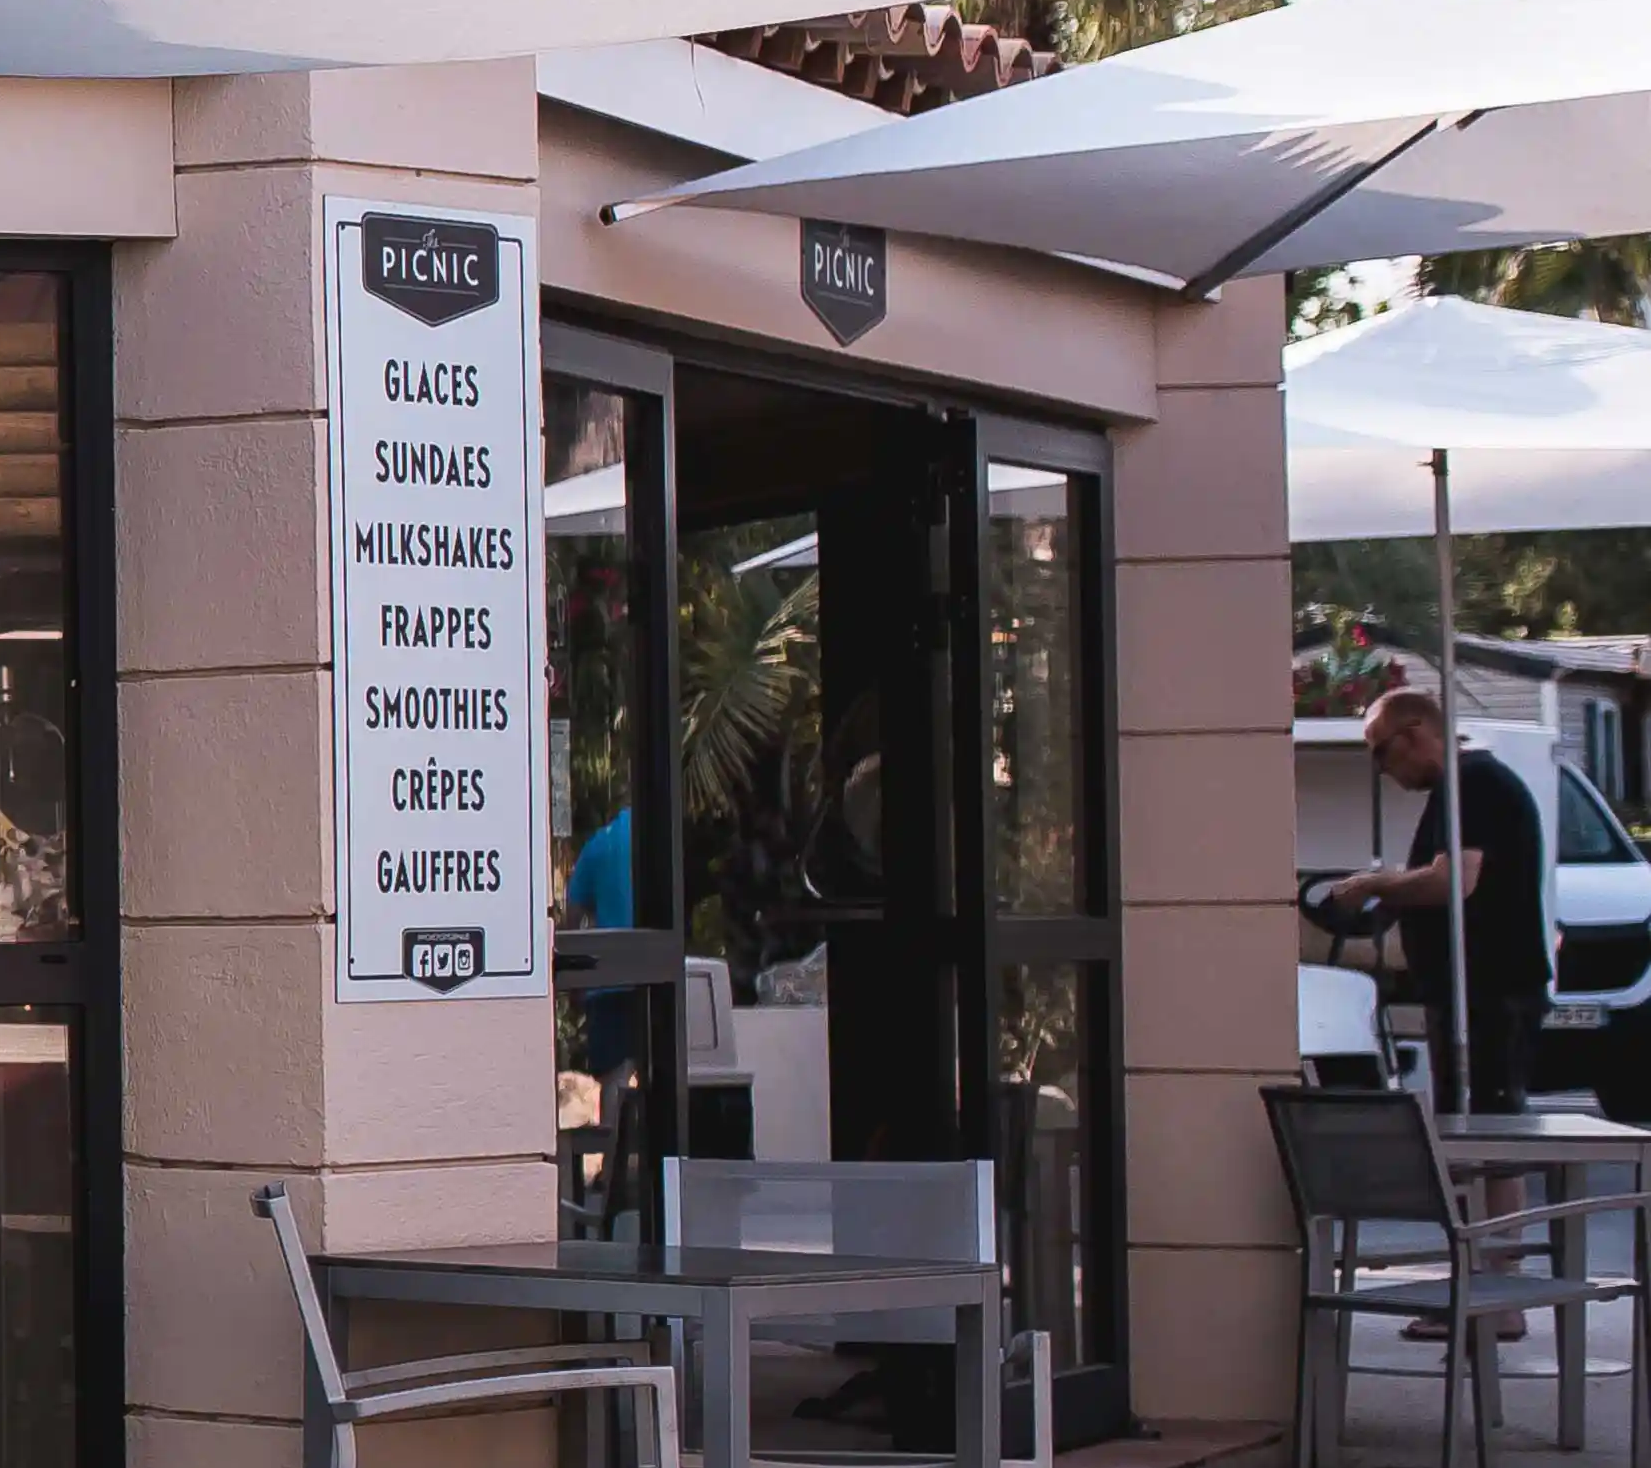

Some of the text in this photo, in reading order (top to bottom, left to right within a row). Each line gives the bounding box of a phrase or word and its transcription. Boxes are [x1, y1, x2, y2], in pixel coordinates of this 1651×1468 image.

[382, 246, 479, 286] PICNIC
[814, 242, 874, 296] PICNIC
[384, 360, 479, 407] GLACES
[375, 440, 490, 489] SUNDAES
[355, 523, 514, 570] MILKSHAKES
[381, 605, 492, 650] FRAPPES
[366, 686, 508, 731] SMOOTHIES
[392, 757, 485, 811] CRÊPES
[377, 849, 501, 893] GAUFFRES
